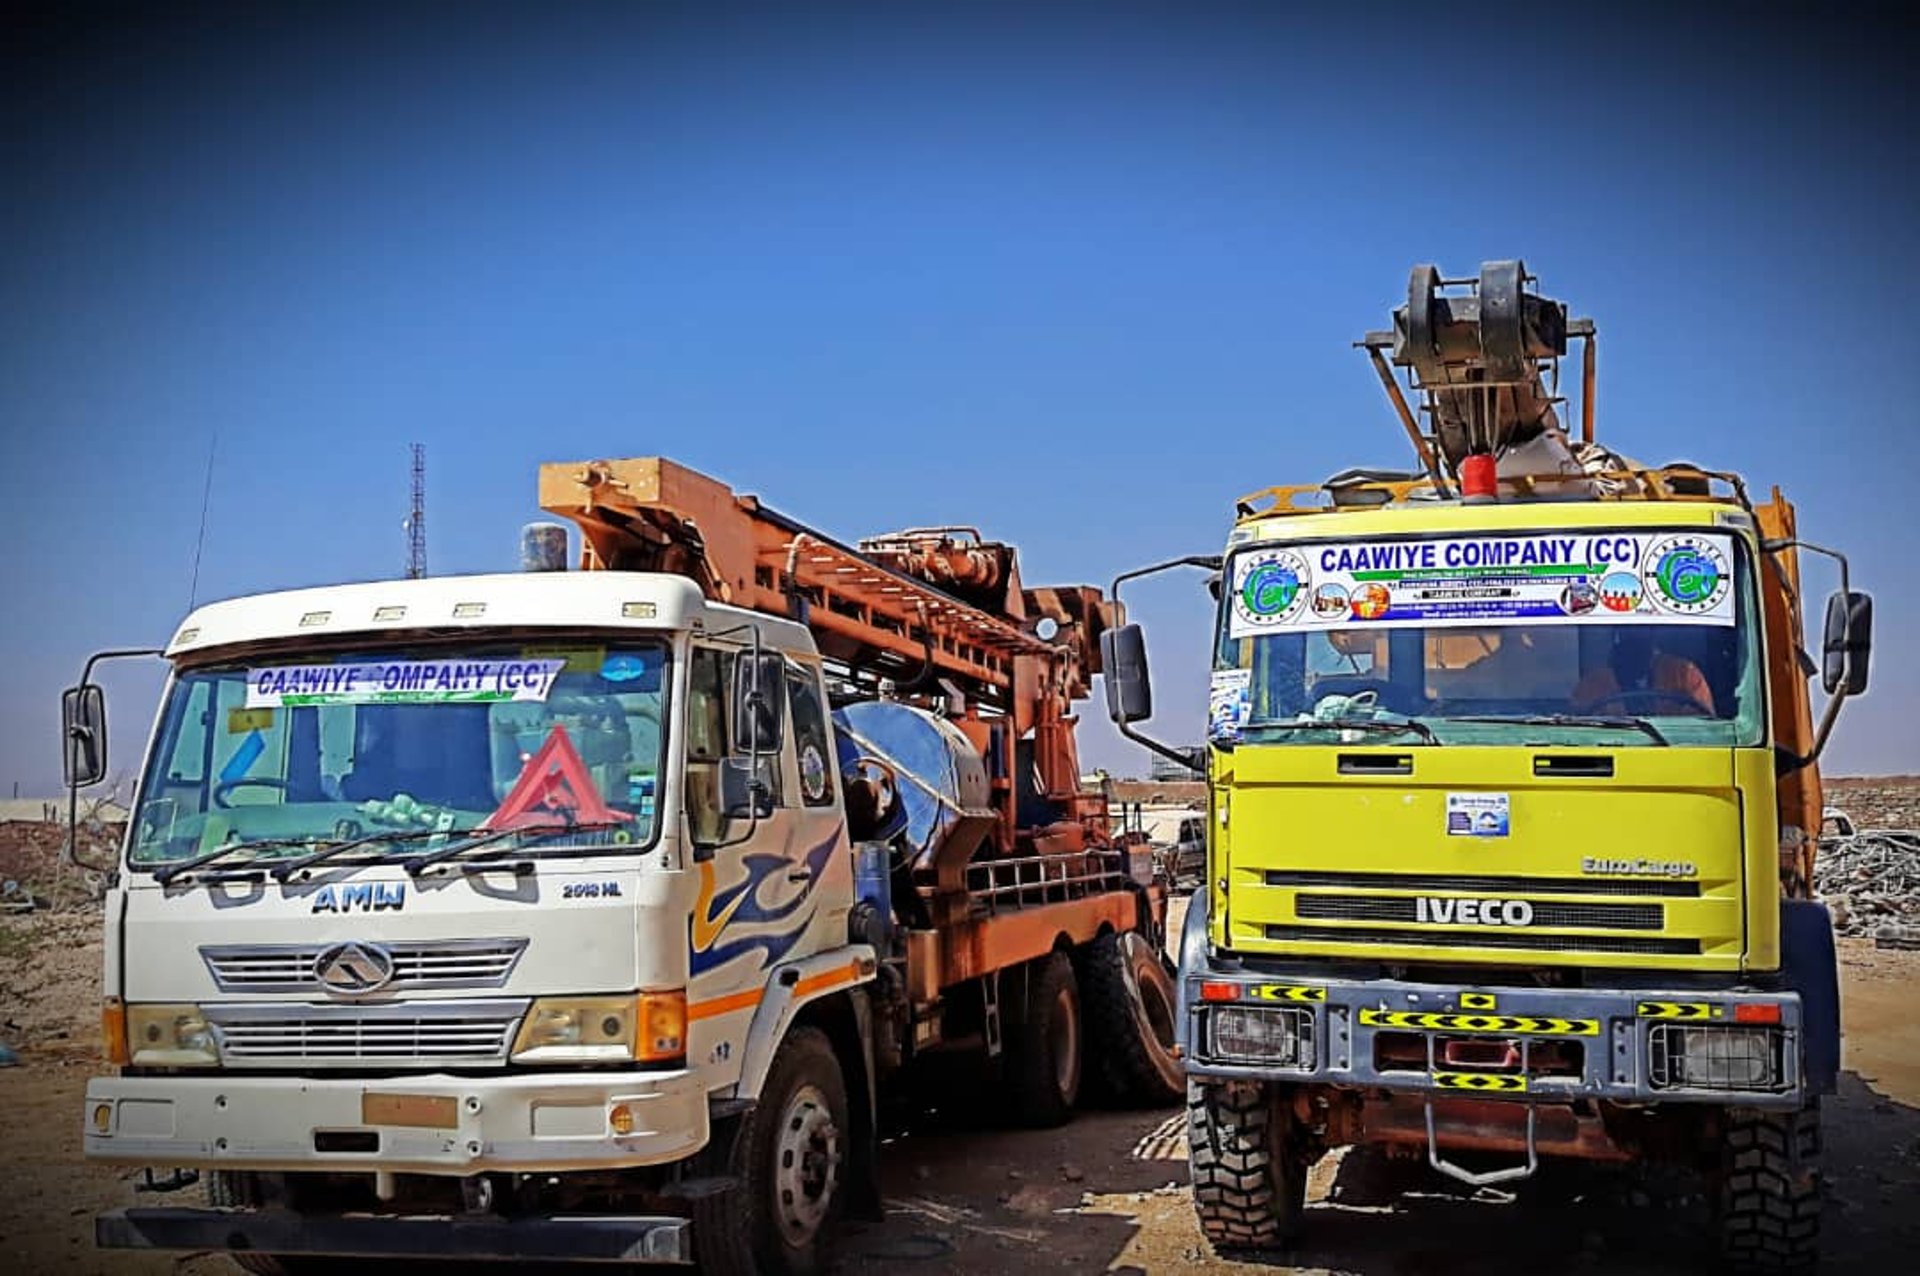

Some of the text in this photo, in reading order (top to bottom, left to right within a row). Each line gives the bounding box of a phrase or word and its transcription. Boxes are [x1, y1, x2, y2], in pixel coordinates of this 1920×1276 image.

[1320, 545, 1435, 572] CAAWIYE
[1445, 540, 1576, 567] COMPANY
[1585, 538, 1640, 568] (CC)
[257, 662, 549, 695] CAAWIYE OMPANY (CC)
[312, 882, 405, 914] AMW
[1415, 896, 1534, 926] IVECO
